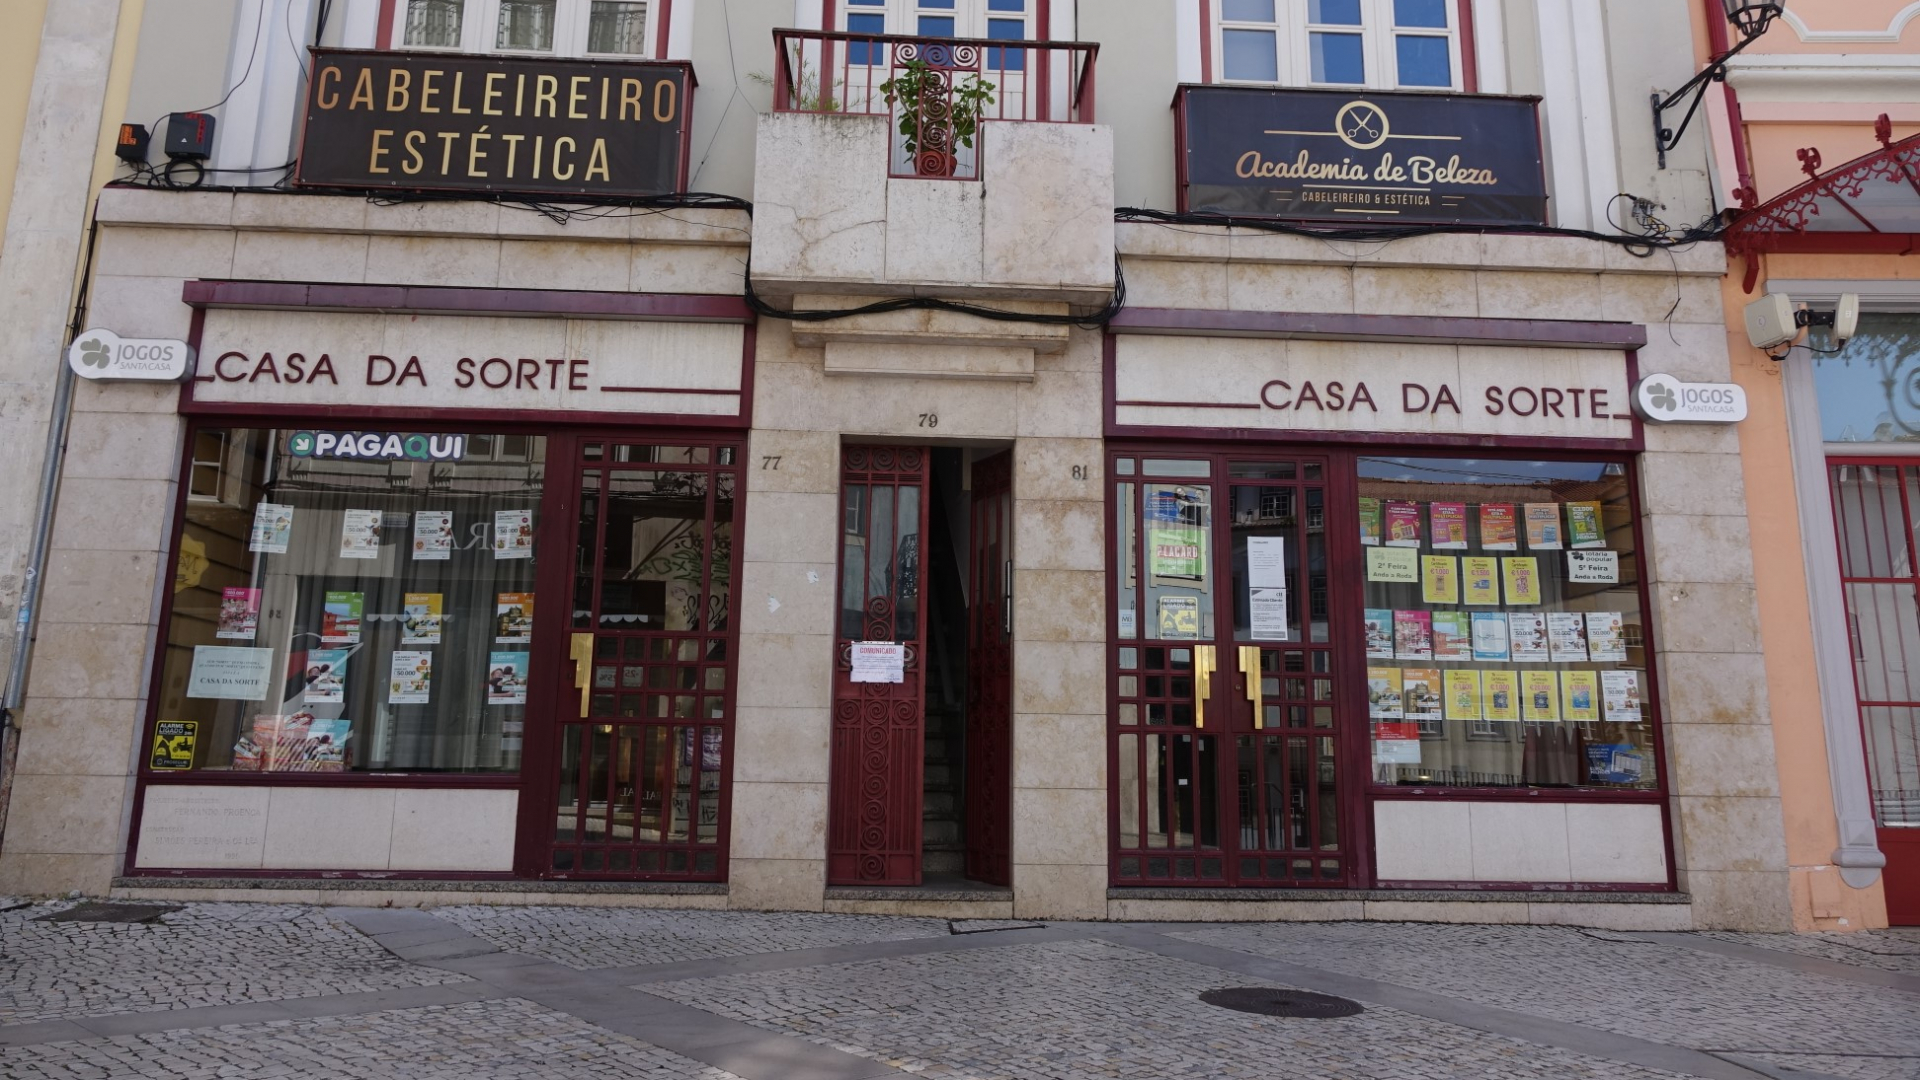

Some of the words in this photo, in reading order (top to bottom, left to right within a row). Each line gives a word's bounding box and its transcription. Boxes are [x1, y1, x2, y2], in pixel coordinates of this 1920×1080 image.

[317, 66, 676, 122] CABELEIREIRO
[369, 125, 610, 182] ESTÉTICA
[1235, 150, 1368, 182] Academia
[1374, 152, 1407, 182] de
[1407, 155, 1498, 185] Beleza
[1302, 191, 1372, 204] CABELEIREIRO
[1374, 193, 1381, 204] &
[1385, 192, 1431, 206] ESTÉTICA
[114, 344, 174, 365] JOGOS
[214, 351, 338, 385] CASA
[366, 355, 427, 387] DA
[455, 357, 590, 391] SORTE
[1260, 379, 1378, 412] CASA
[1402, 383, 1461, 414] DA
[1484, 385, 1609, 418] SORTE
[1680, 387, 1735, 405] JOGOS
[918, 413, 938, 428] 79
[316, 432, 463, 459] PAGAQUI
[762, 456, 781, 471] 77
[1072, 465, 1088, 480] 81
[1157, 545, 1198, 558] PLACARD
[860, 647, 897, 655] COMUNICADO
